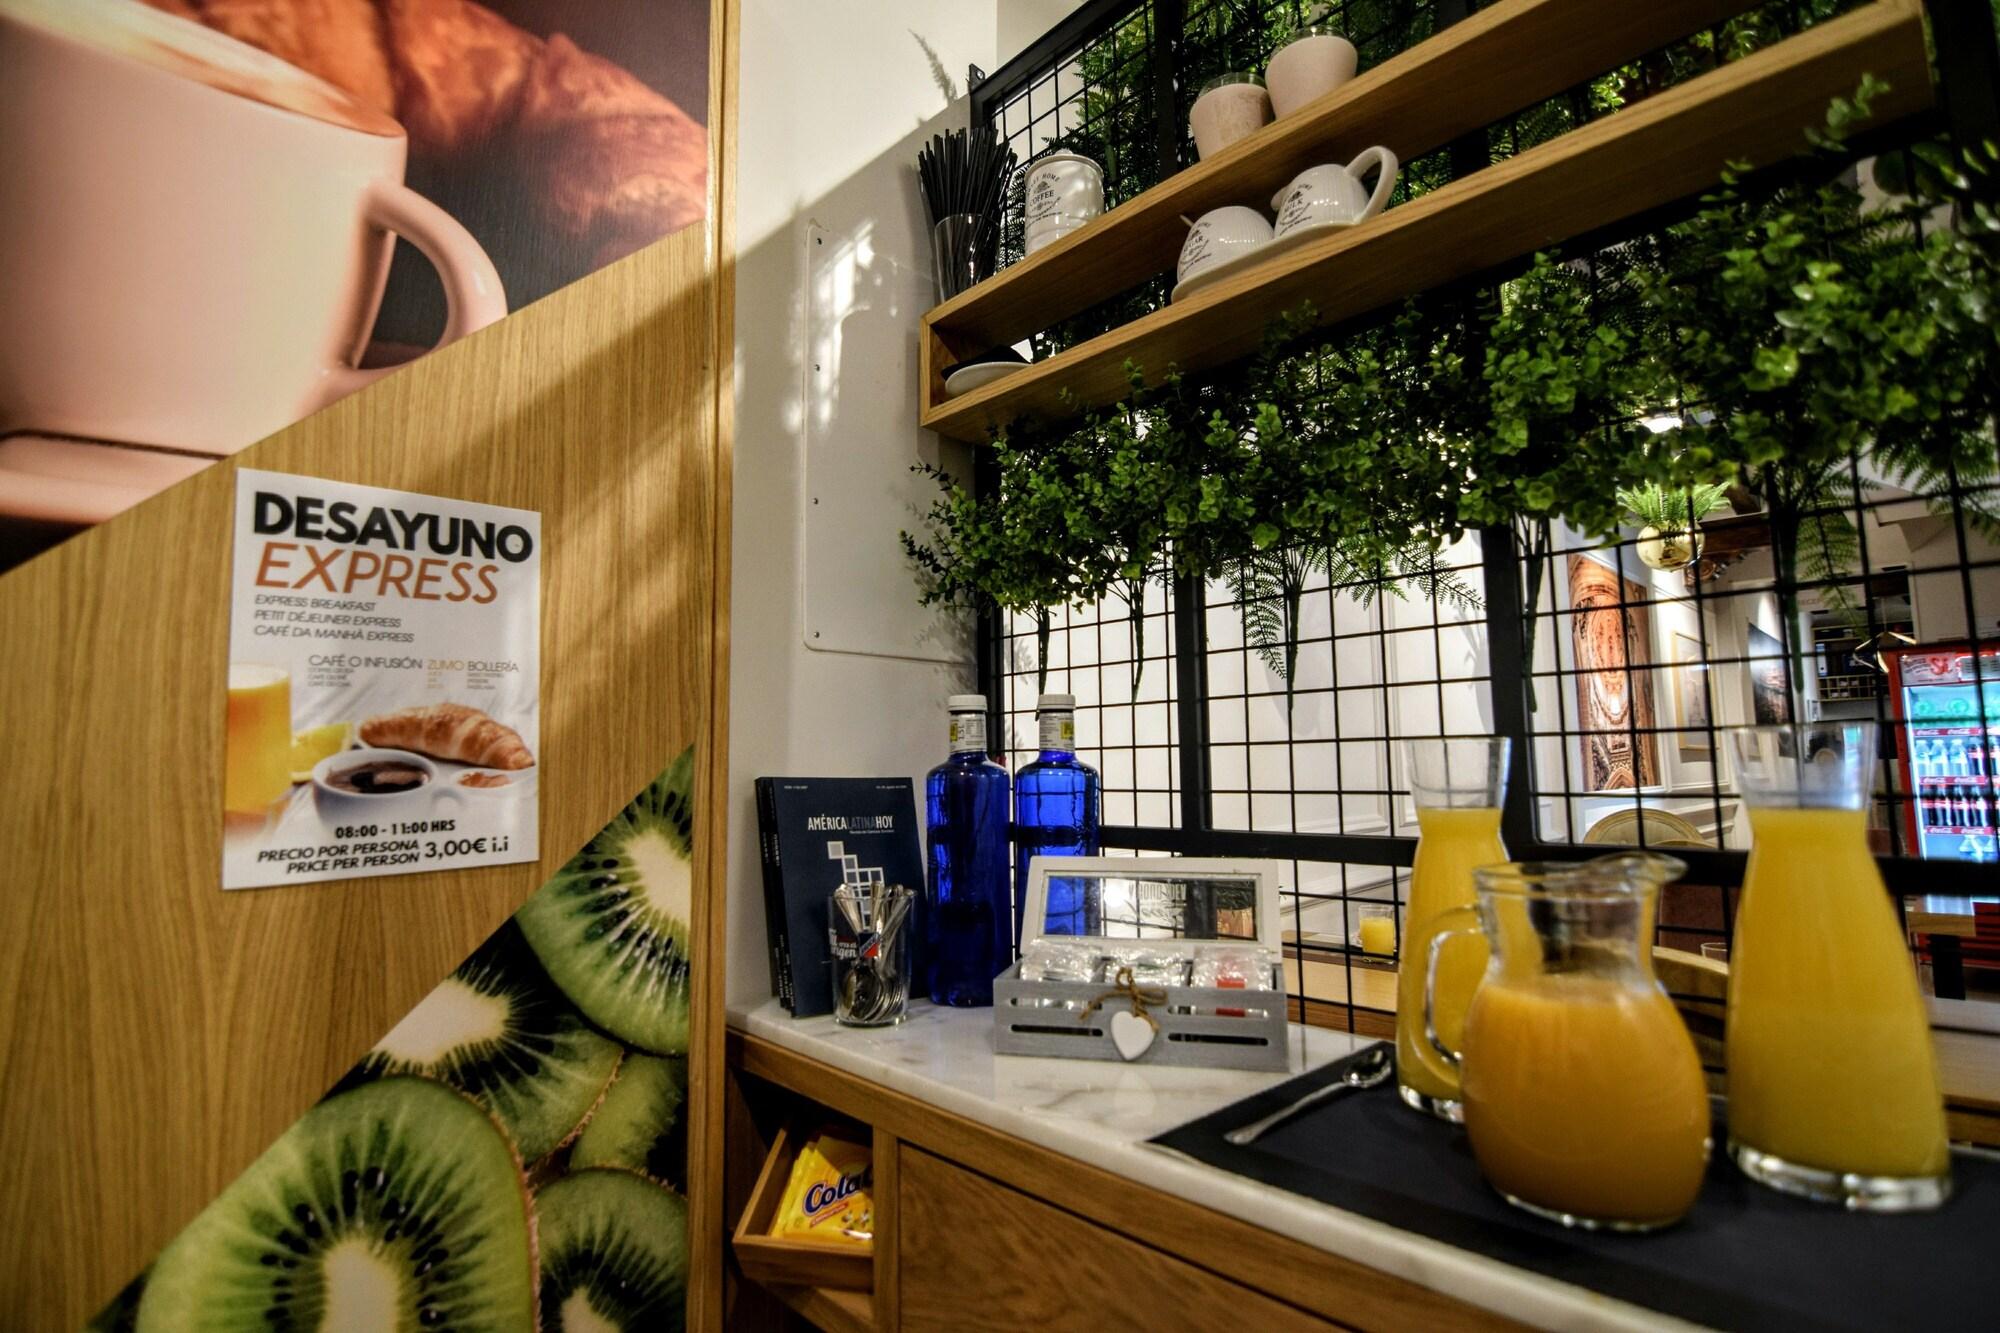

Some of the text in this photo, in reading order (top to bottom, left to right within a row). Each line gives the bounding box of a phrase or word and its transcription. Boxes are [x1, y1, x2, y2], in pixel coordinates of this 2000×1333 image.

[1029, 189, 1055, 206] COFFEE
[253, 491, 534, 563] DESAYUNO
[255, 541, 499, 604] EXPRESS
[255, 594, 377, 612] EXPRESS BREAKFAST
[254, 609, 402, 628] PETIT DÉJEUNER EXPRESS
[254, 624, 290, 637] CAFÉ
[291, 627, 312, 638] DA
[366, 631, 415, 643] EXPRESS
[308, 653, 423, 669] CAFÉ O INFUSIÓN
[427, 659, 465, 671] ZUMO
[467, 660, 519, 673] BOLLERÍA
[335, 824, 379, 839] 08:00
[391, 821, 428, 836] 11:00
[430, 819, 456, 832] HRS
[257, 840, 420, 863] PRECIO POR PERSONA
[424, 837, 487, 861] 3,00€
[286, 852, 421, 875] PRICE PER PERSON
